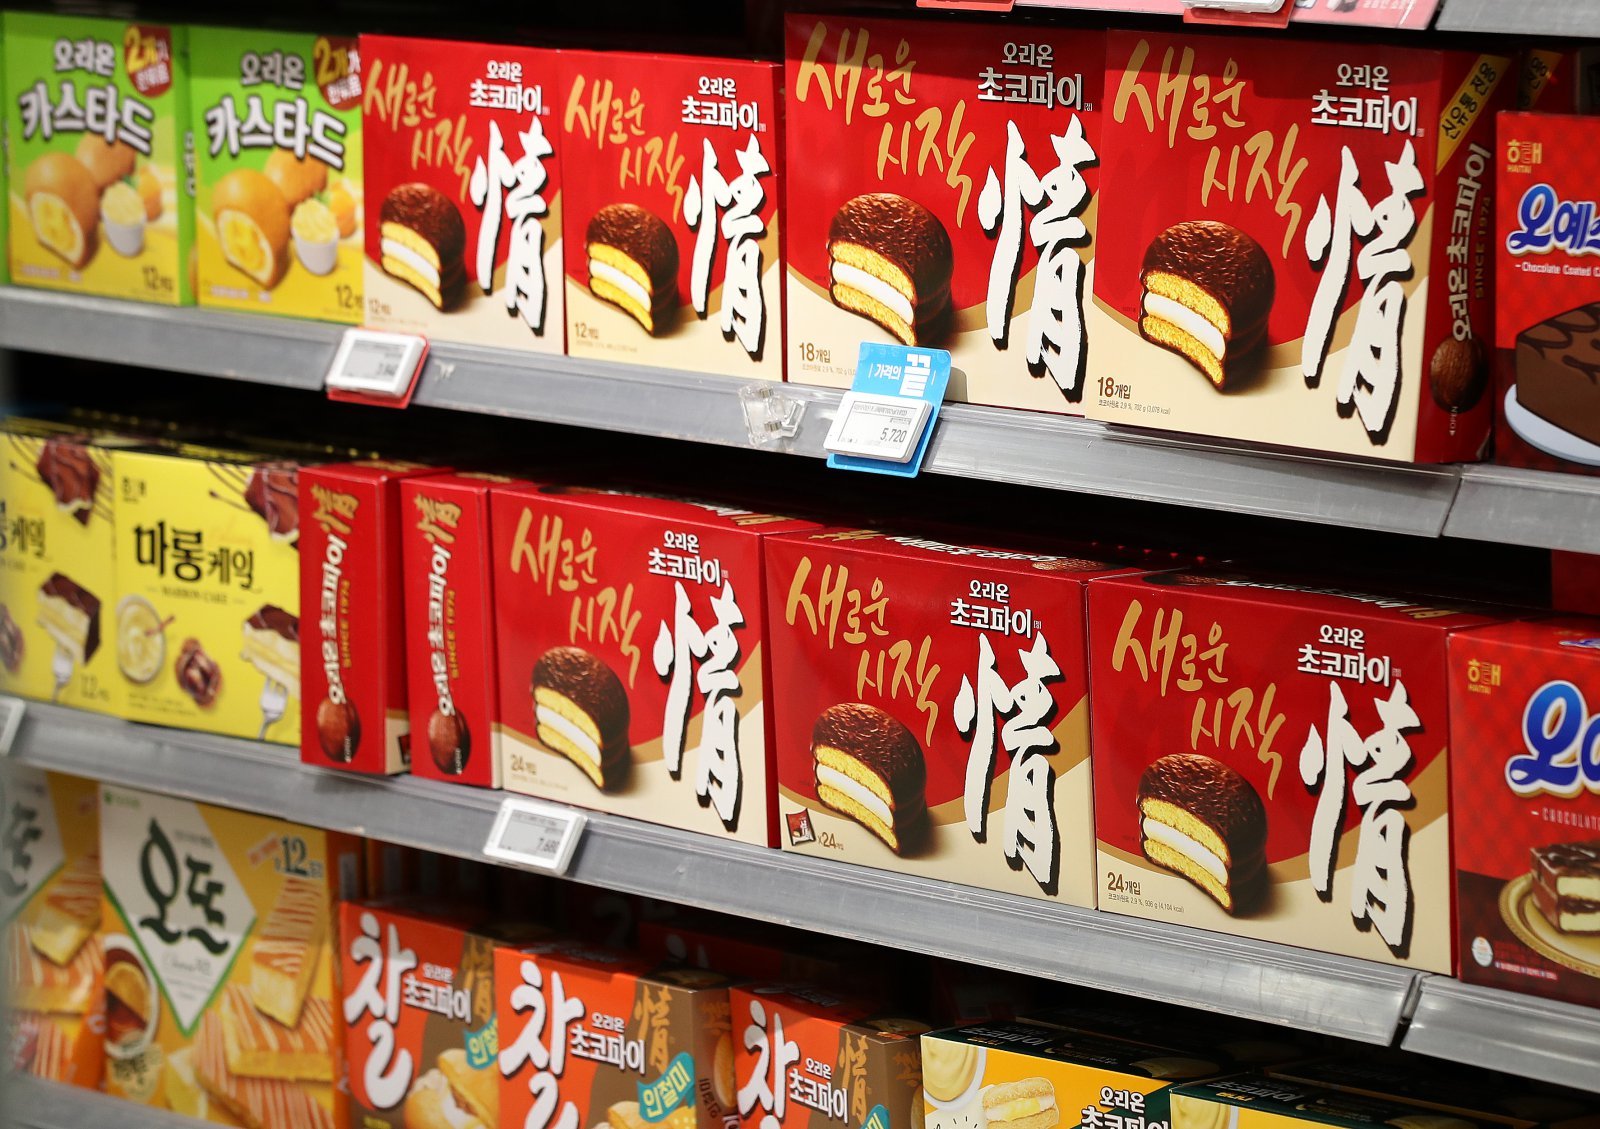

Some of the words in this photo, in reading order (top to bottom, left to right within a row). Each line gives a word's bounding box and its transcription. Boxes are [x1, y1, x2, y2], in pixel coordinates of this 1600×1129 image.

[54, 38, 116, 77] 오리온
[240, 51, 305, 89] 오리온
[486, 60, 523, 82] 오리온
[698, 76, 737, 98] 오리온
[797, 21, 917, 126] 새로운
[1001, 42, 1054, 69] 오리온
[1336, 62, 1390, 91] 오리온
[19, 80, 154, 155] 카스타드
[363, 58, 437, 132] 새로운
[469, 79, 543, 115] 초코파이
[564, 74, 647, 149] 새로운
[681, 95, 759, 132] 초코파이
[977, 67, 1084, 111] 초코파이
[1112, 38, 1247, 149] 새로운
[1310, 89, 1418, 137] 초코파이
[1441, 92, 1478, 140] 신유통
[1470, 62, 1497, 96] 전용
[204, 94, 347, 171] 카스타드
[411, 114, 473, 203] 시작
[876, 99, 976, 229] 시작
[619, 131, 685, 224] 시작
[1201, 123, 1309, 259] 시작
[1446, 143, 1492, 265] 초코파이
[469, 115, 553, 337] 情
[683, 132, 771, 361] 情
[978, 113, 1101, 403] 情
[1302, 138, 1427, 445] 情
[1475, 240, 1485, 298] SINCE
[1522, 261, 1561, 274] Chocolate
[1563, 265, 1591, 277] Coated
[1448, 267, 1473, 341] 오리온
[799, 342, 831, 363] 18개입
[874, 363, 902, 380] 가격의
[899, 353, 932, 397] 끝
[1097, 377, 1131, 399] 18개입
[510, 507, 598, 596] 새로운
[648, 547, 722, 587] 초코파이
[663, 530, 700, 551] 오리온
[320, 533, 347, 637] 초코파이
[428, 543, 452, 649] 초코파이
[785, 556, 889, 649] 새로운
[969, 579, 1009, 602] 오리온
[570, 583, 642, 690] 시작
[950, 598, 1033, 639] 초코파이
[1112, 599, 1229, 697] 새로운
[1318, 624, 1364, 650] 오리온
[322, 640, 347, 705] 오리온
[431, 651, 456, 716] 오리온
[857, 635, 941, 747] 시작
[1297, 643, 1391, 687] 초코파이
[652, 579, 746, 832] 情
[954, 630, 1066, 896] 情
[1191, 682, 1286, 800] 시작
[1299, 679, 1425, 959] 情
[1107, 872, 1141, 895] 24개입
[403, 974, 472, 1024] 초코파이
[422, 962, 454, 984] 오리온
[343, 911, 418, 1110] 찰
[591, 1012, 625, 1033] 오리온
[498, 959, 585, 1129] 찰
[570, 1024, 646, 1075] 초코파이
[805, 1057, 832, 1079] 오리온
[642, 1060, 692, 1118] 인절미
[789, 1068, 849, 1125] 초코파이
[1100, 1085, 1146, 1114] 오리온
